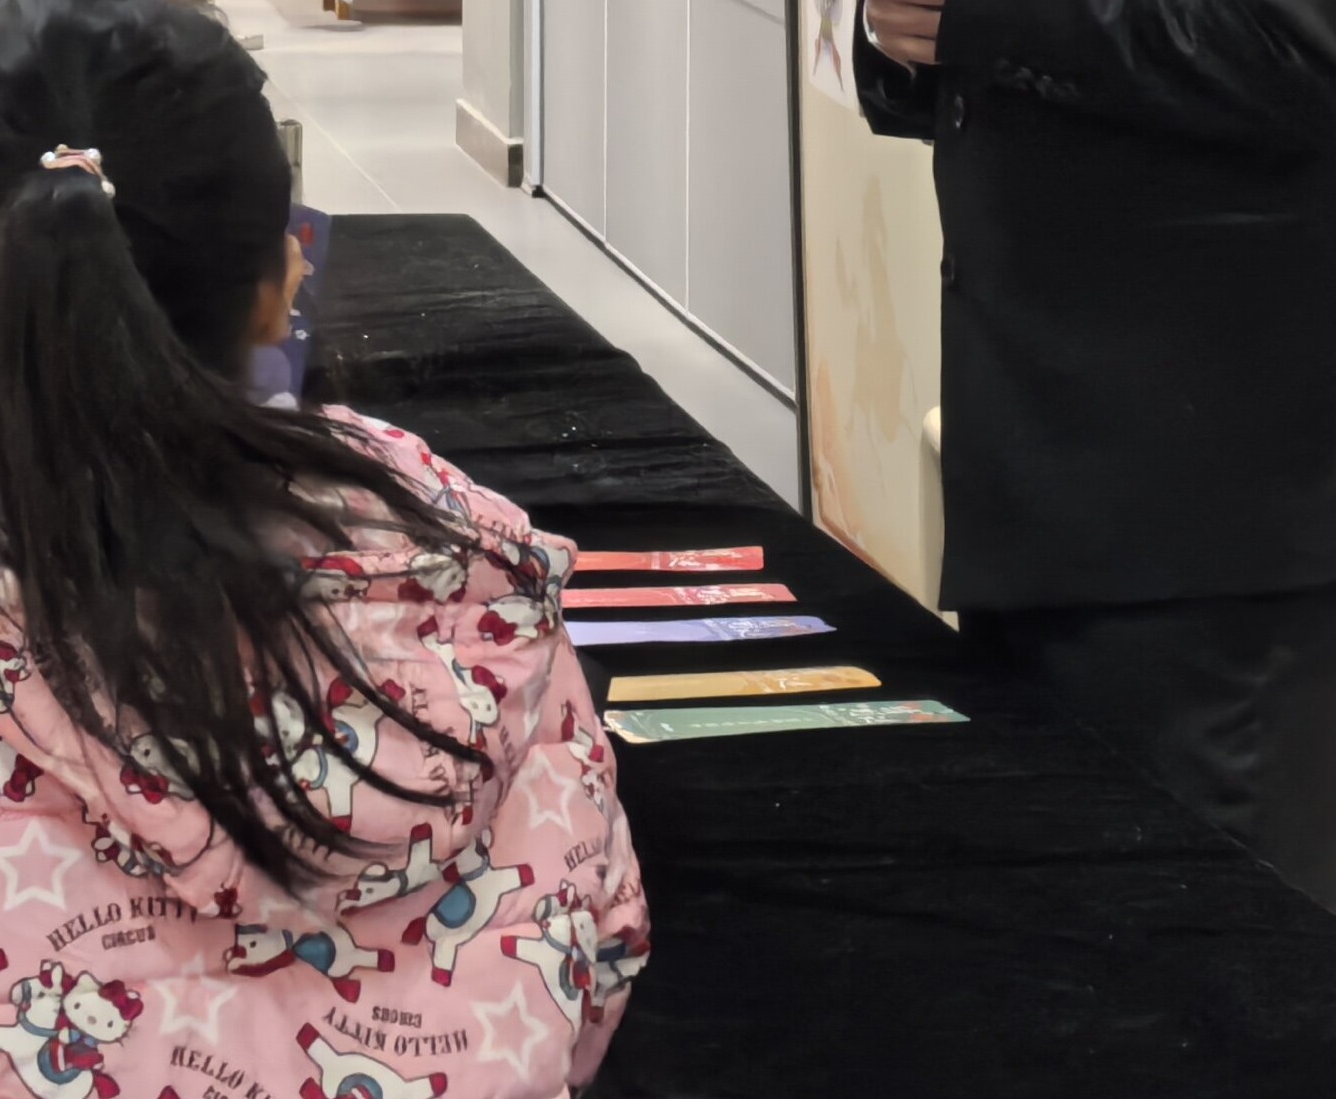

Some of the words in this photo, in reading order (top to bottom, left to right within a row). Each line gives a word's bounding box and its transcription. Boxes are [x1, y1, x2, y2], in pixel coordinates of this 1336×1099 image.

[46, 902, 122, 952] HELLO
[322, 1005, 386, 1052] KITTY
[394, 1028, 469, 1058] HELLO
[170, 1046, 246, 1090] HELLO
